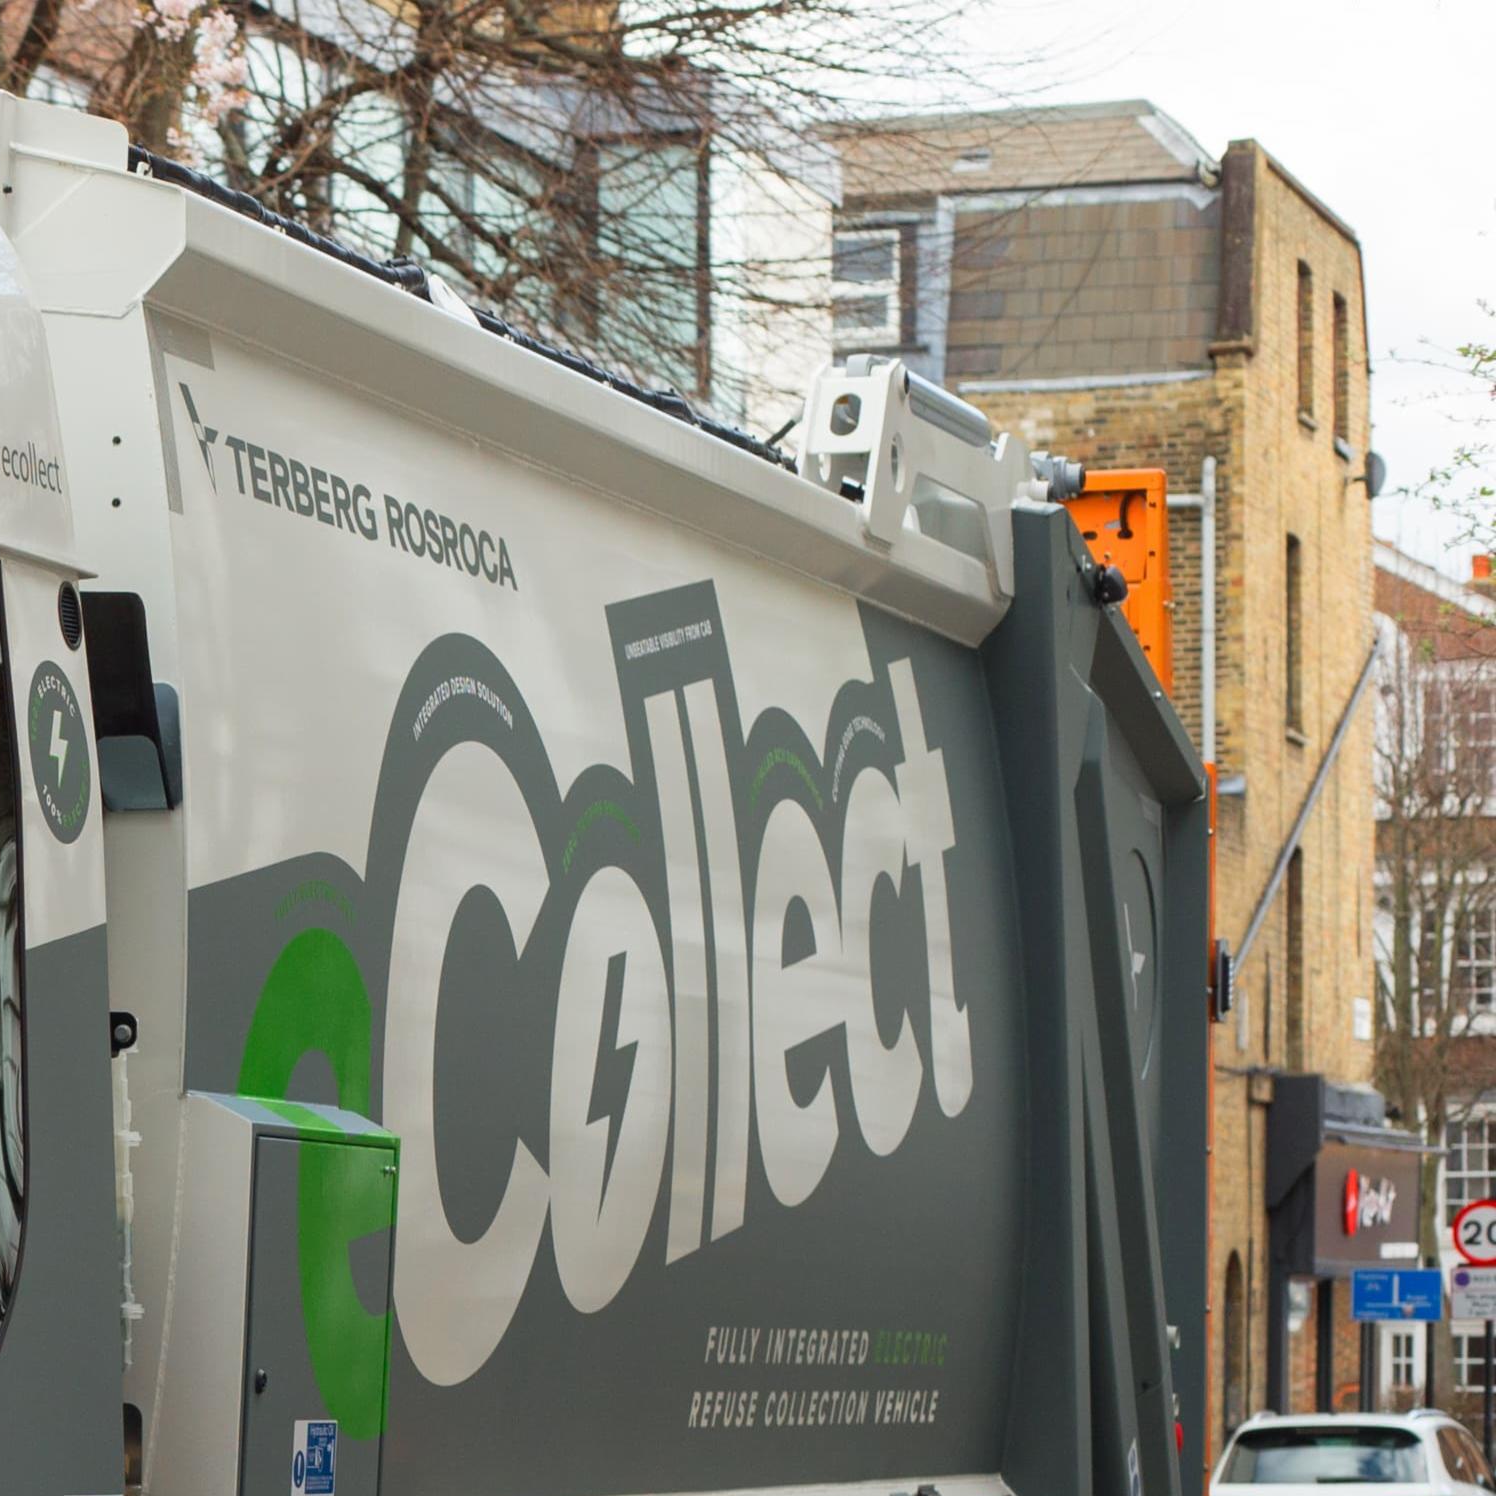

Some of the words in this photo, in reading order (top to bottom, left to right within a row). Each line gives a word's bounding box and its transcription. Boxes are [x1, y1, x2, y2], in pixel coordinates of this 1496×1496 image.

[225, 435, 379, 542] TERBERG
[383, 493, 519, 592] ROSROCA
[684, 621, 702, 643] FROM
[701, 618, 713, 638] CAB
[37, 675, 76, 718] ELECTRIC
[411, 680, 451, 742] INTEGRATED
[450, 675, 478, 696] DESIGN
[476, 680, 514, 731] SOLUTION
[42, 783, 63, 826] 100%
[704, 1326, 761, 1365] FULLY
[764, 1328, 870, 1366] INTEGRATED
[873, 1330, 949, 1367] ELECTRIC
[688, 1390, 759, 1429] REFUSE
[764, 1389, 868, 1427] COLLECTION
[874, 1389, 939, 1424] VEHICLE
